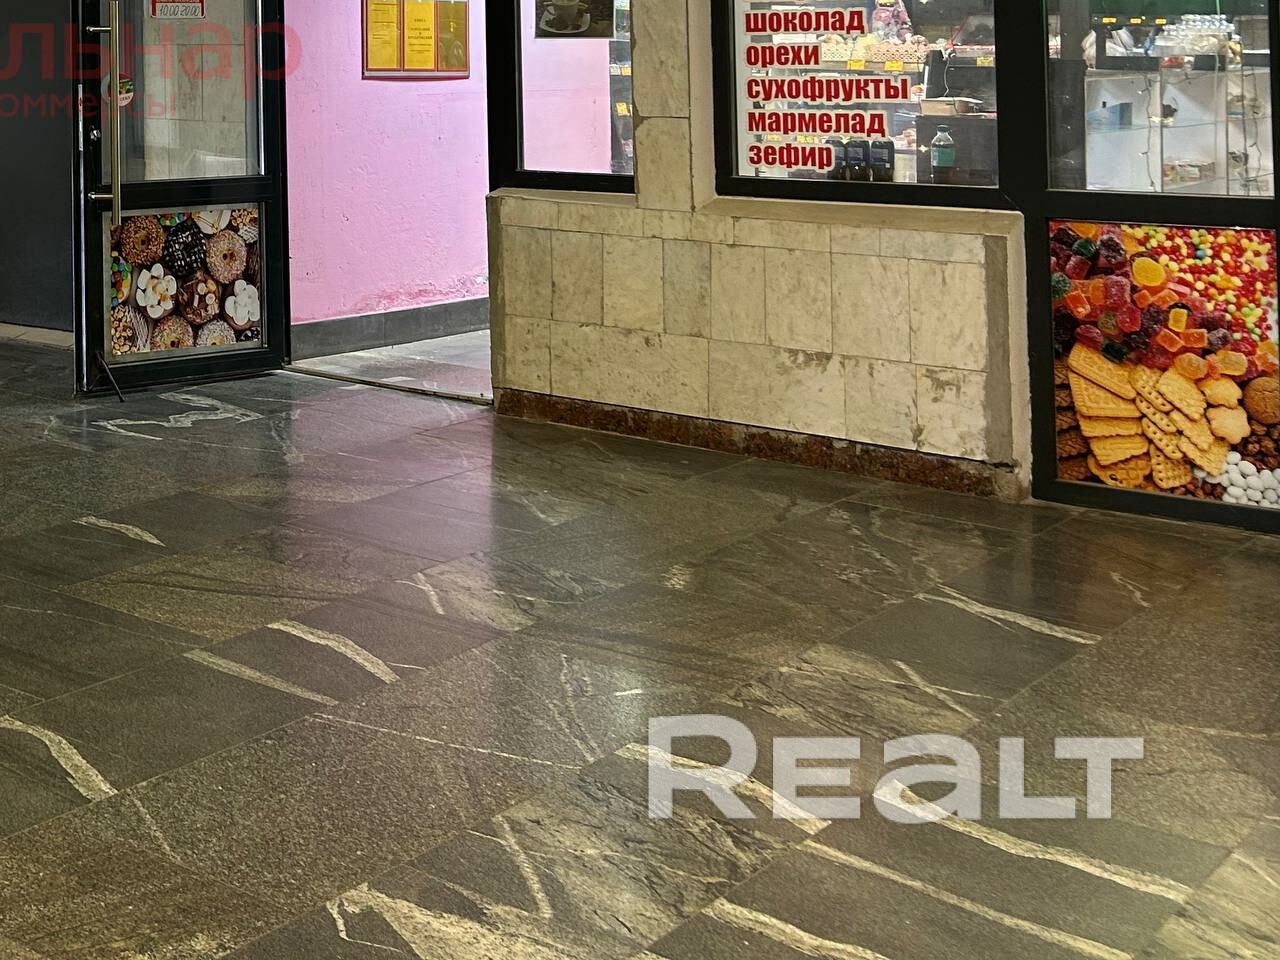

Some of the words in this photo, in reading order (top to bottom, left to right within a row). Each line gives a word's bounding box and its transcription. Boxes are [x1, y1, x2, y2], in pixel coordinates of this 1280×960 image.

[745, 10, 865, 34] шоколад
[746, 44, 819, 68] орехи
[746, 76, 908, 101] сухофрукты
[748, 111, 885, 137] мармелад
[749, 143, 833, 169] зефир
